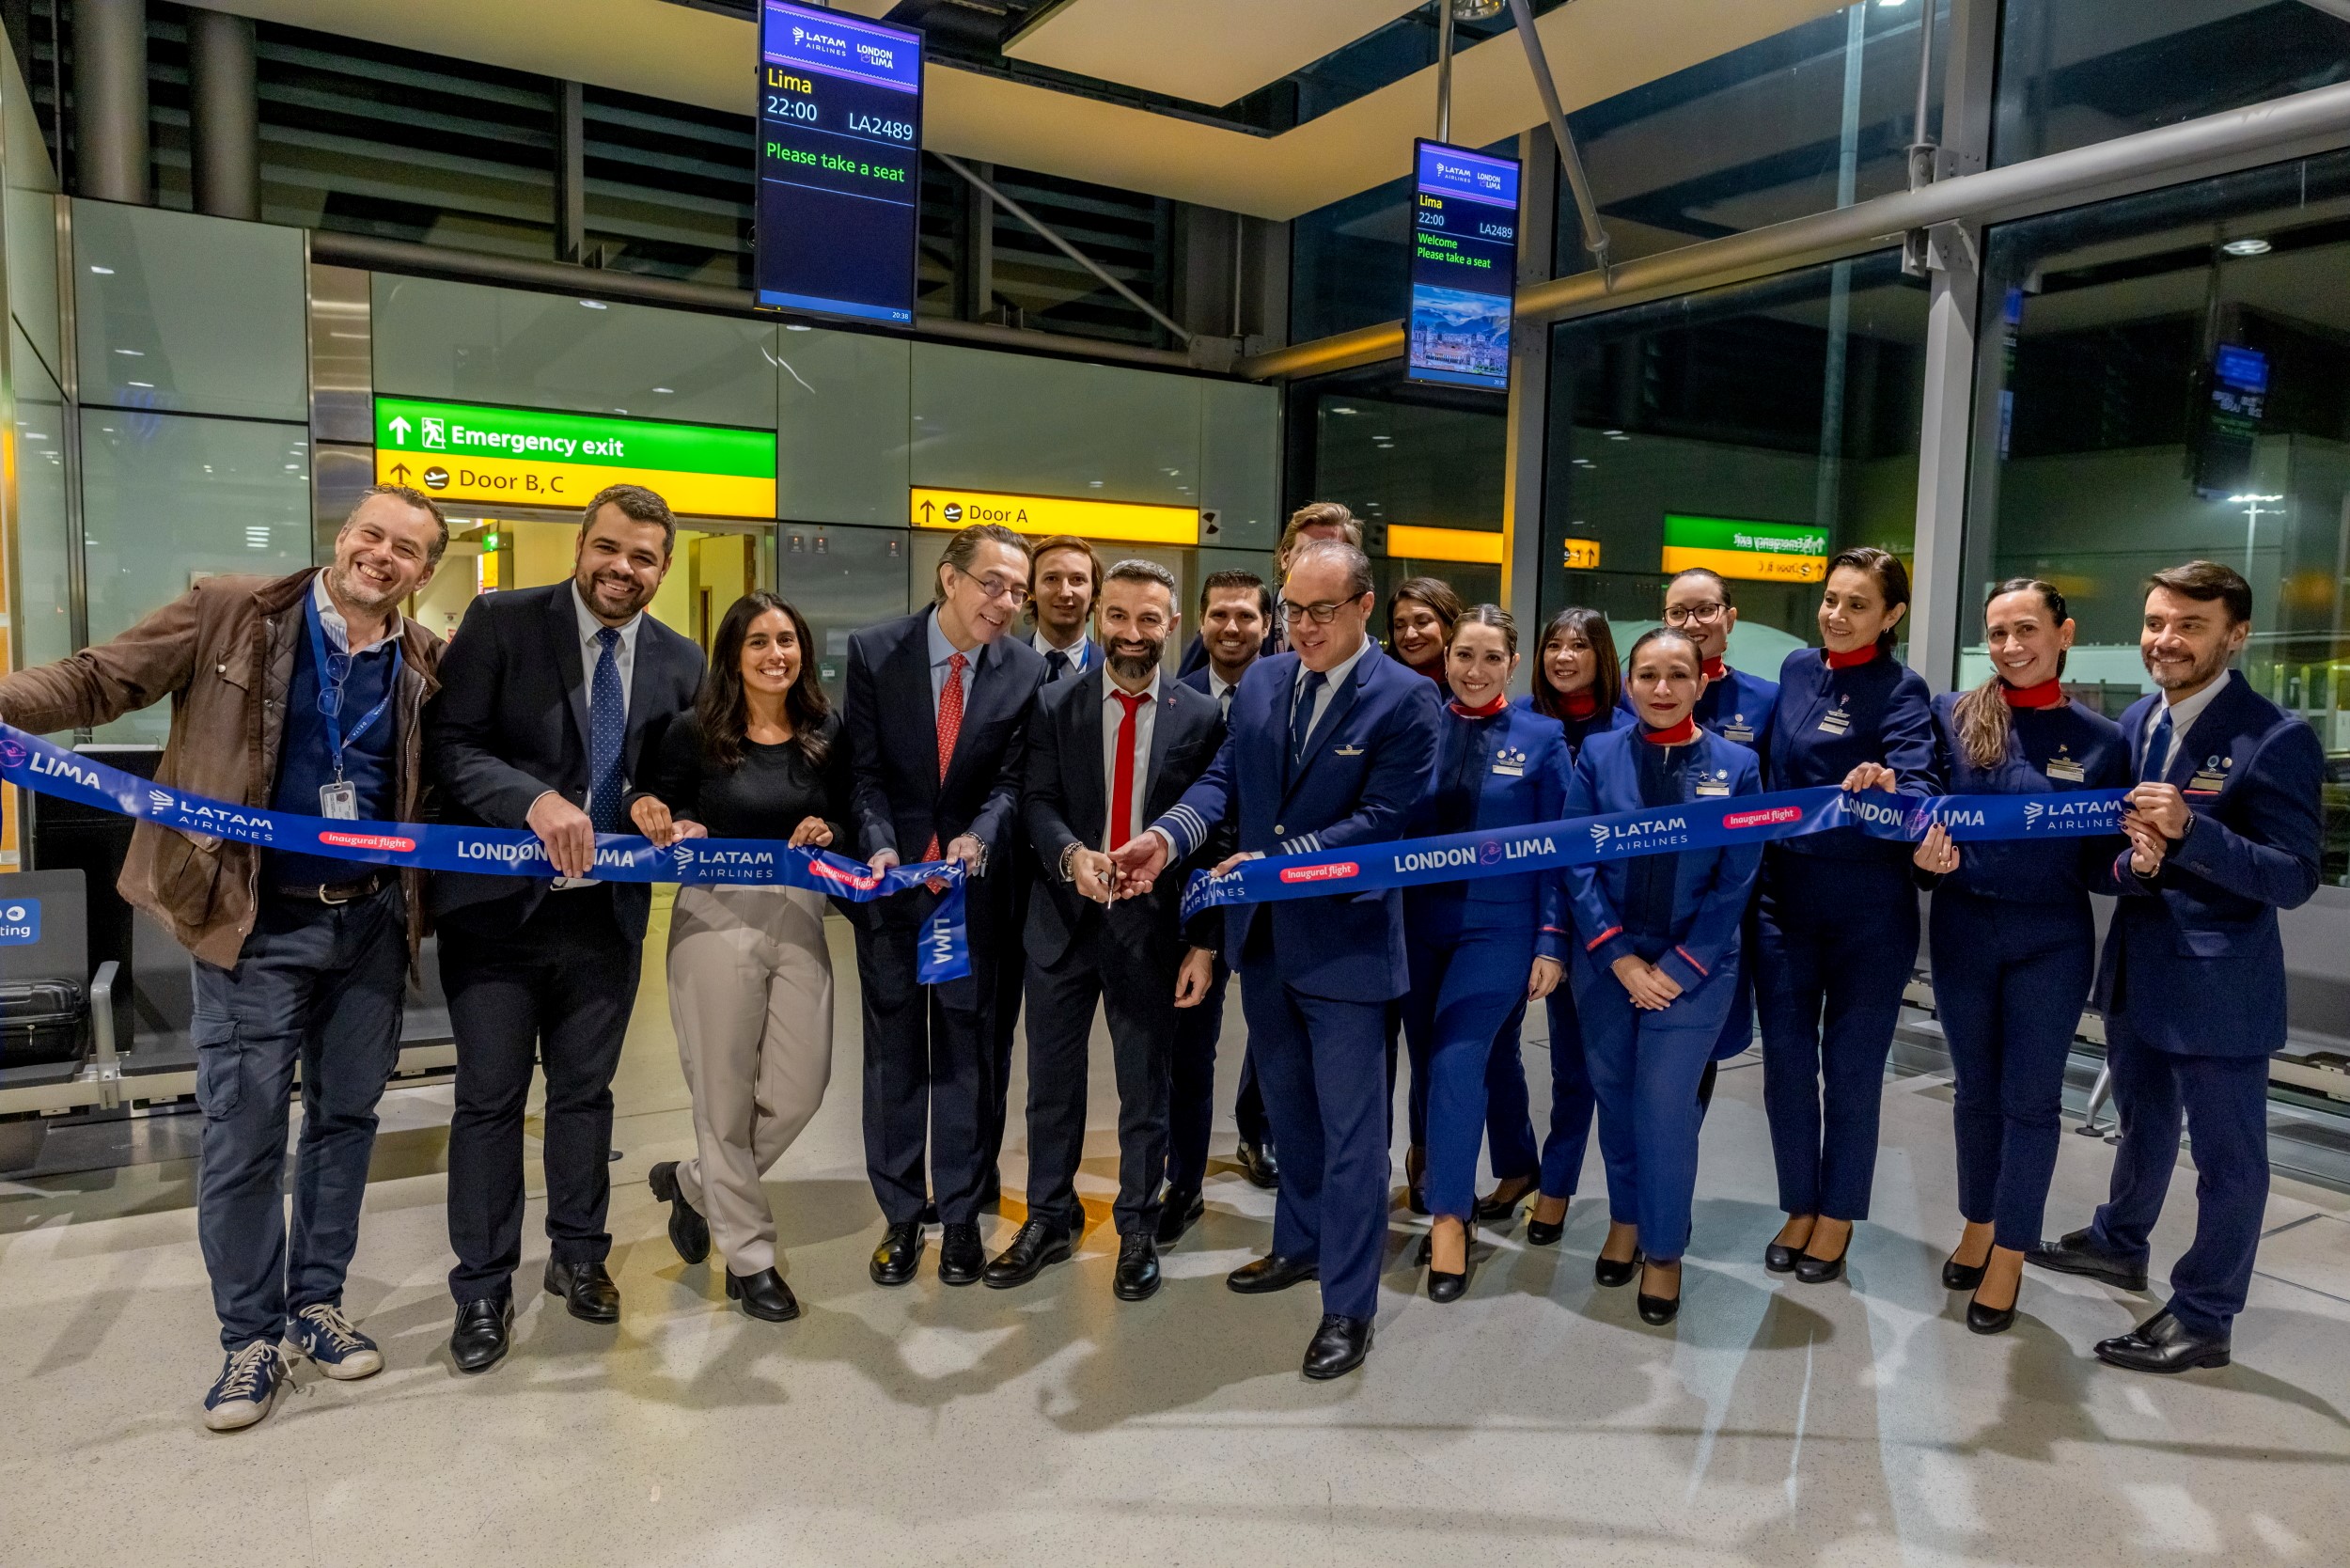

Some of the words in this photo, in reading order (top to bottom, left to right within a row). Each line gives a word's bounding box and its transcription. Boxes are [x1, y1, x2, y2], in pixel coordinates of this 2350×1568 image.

[806, 32, 846, 49] LATAM
[806, 43, 846, 57] AIRLINES
[856, 43, 893, 60] LONDON
[870, 55, 894, 70] LIMA
[768, 68, 812, 94] Lima
[767, 95, 817, 121] 22:00
[849, 112, 913, 141] LA2489
[766, 142, 816, 165] Please
[821, 153, 855, 173] take
[860, 164, 870, 176] a
[873, 165, 905, 182] seat
[1444, 174, 1471, 183] AIRLINES
[1445, 165, 1471, 178] LATAM
[1477, 172, 1501, 182] LONDON
[1485, 181, 1501, 191] LIMA
[1419, 195, 1443, 210] Lima
[1418, 212, 1445, 227] 22:00
[1480, 223, 1512, 239] LA2489
[1418, 232, 1458, 249] Welcome
[1417, 246, 1444, 260] Please
[1446, 252, 1465, 264] take
[1466, 257, 1472, 265] a
[1473, 259, 1492, 269] seat
[892, 311, 909, 320] 20:38
[452, 425, 577, 458] Emergency
[582, 436, 624, 458] exit
[460, 469, 518, 490] Door
[550, 476, 564, 494] C
[969, 505, 1011, 524] Door
[1016, 509, 1028, 524] A
[29, 752, 101, 791] LIMA
[180, 801, 274, 831] LATAM
[1730, 810, 1770, 826] Inaugural
[1771, 808, 1794, 823] flight
[1837, 798, 1904, 826] LONDON
[2048, 800, 2123, 816] LATAM
[179, 816, 274, 842] AIRLINES
[1614, 817, 1687, 838] LATAM
[2047, 818, 2122, 830] AIRLINE
[328, 833, 377, 848] Inaugural
[378, 837, 407, 850] flight
[1615, 835, 1688, 852] AIRLINES
[699, 851, 774, 865] LATAM
[1394, 847, 1477, 873] LONDON
[1505, 837, 1557, 860] LIMA
[697, 869, 774, 879] AIRLINES
[815, 864, 853, 883] Inaugural
[853, 877, 876, 887] flight
[1288, 866, 1327, 880] Inaugural
[1328, 864, 1352, 878] flight
[1185, 870, 1244, 902] LATAM
[1185, 887, 1246, 915] AIRLINES
[932, 918, 952, 965] LIMA
